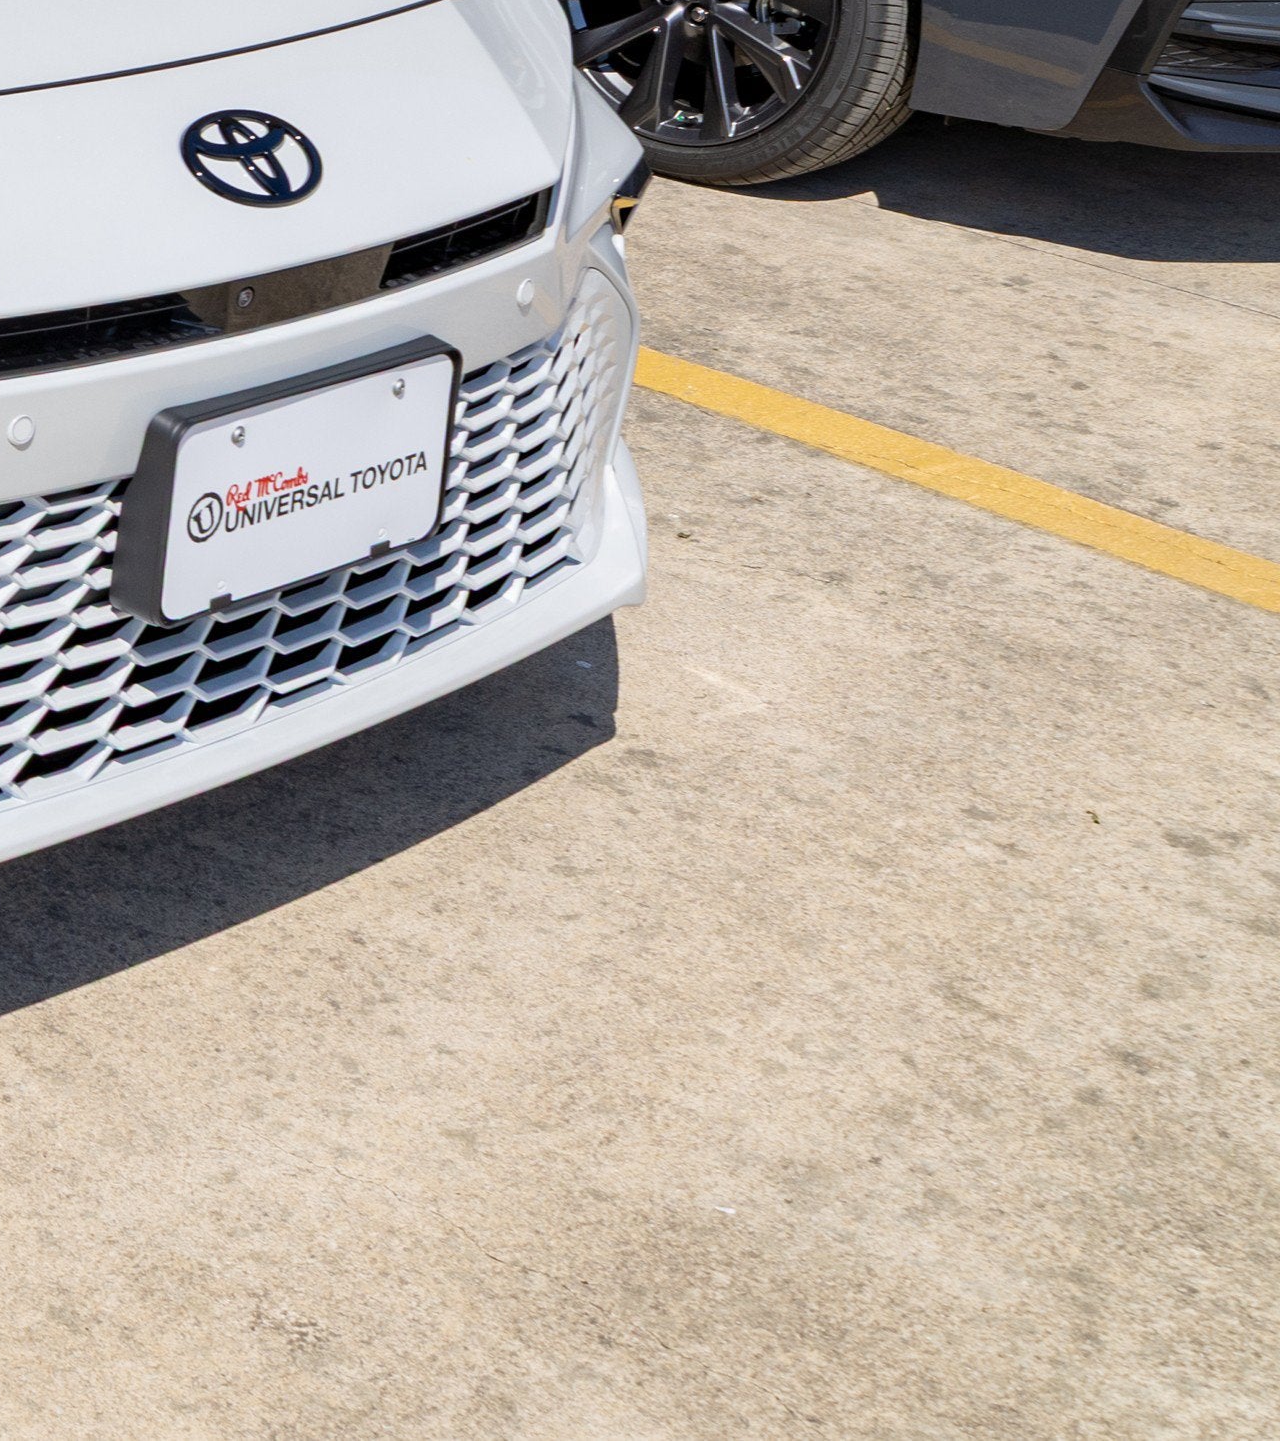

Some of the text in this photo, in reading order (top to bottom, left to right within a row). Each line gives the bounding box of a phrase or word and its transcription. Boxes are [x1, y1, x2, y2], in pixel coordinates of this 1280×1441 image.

[224, 451, 428, 532] UNIVERSAL TOYOTA
[226, 481, 253, 511] Red
